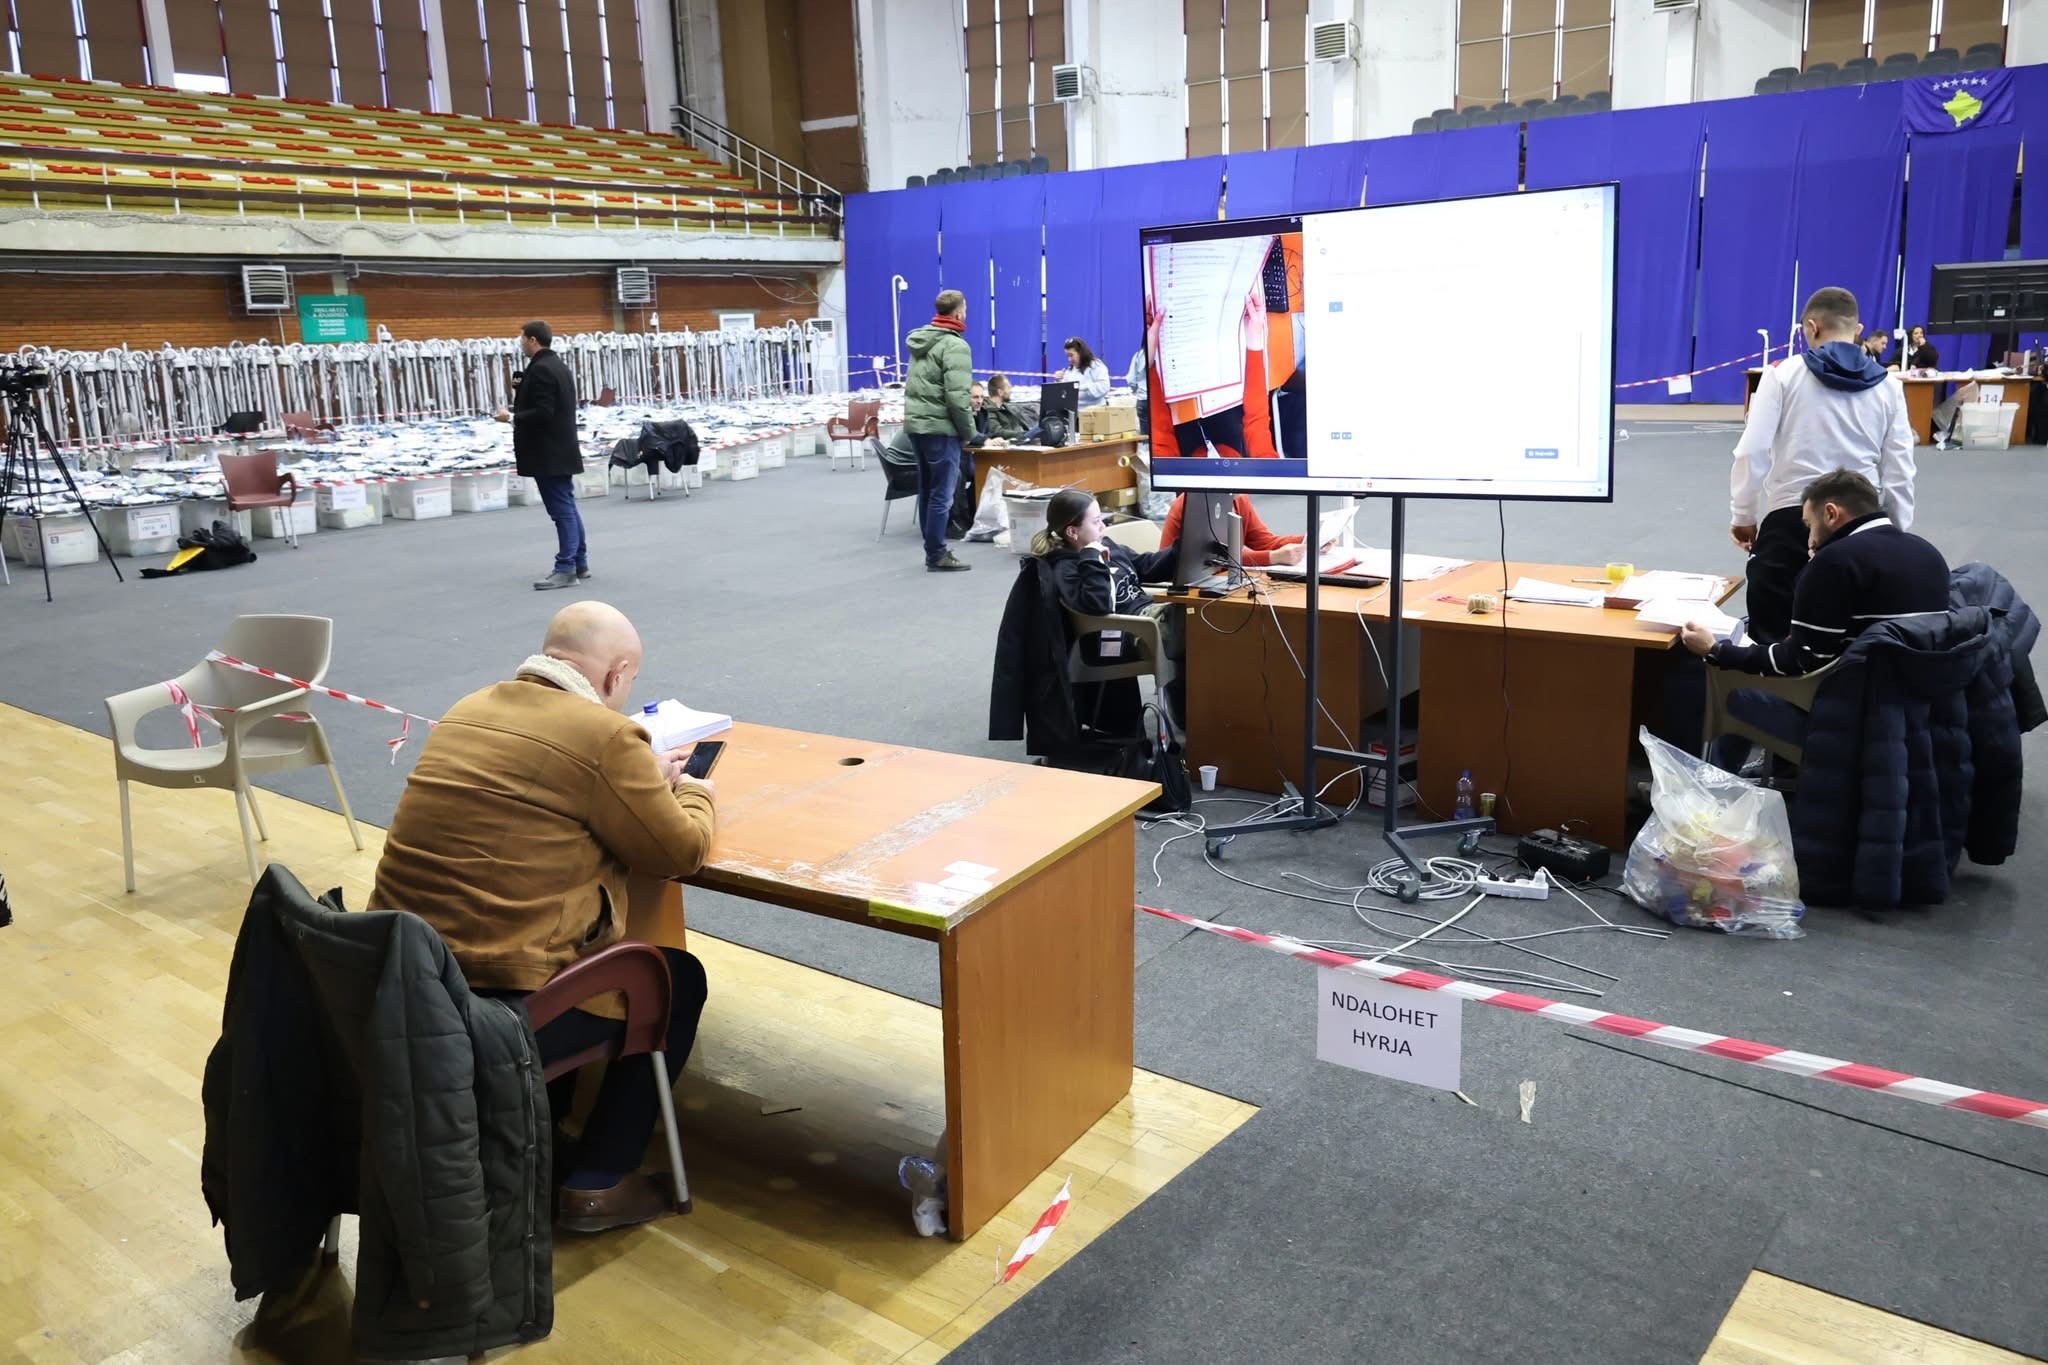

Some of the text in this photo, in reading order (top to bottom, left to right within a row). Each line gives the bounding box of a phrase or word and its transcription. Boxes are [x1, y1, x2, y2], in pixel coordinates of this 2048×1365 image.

[1984, 393, 1999, 404] 14
[1331, 991, 1439, 1029] NDALOHET
[1352, 1029, 1413, 1057] HYRJA
